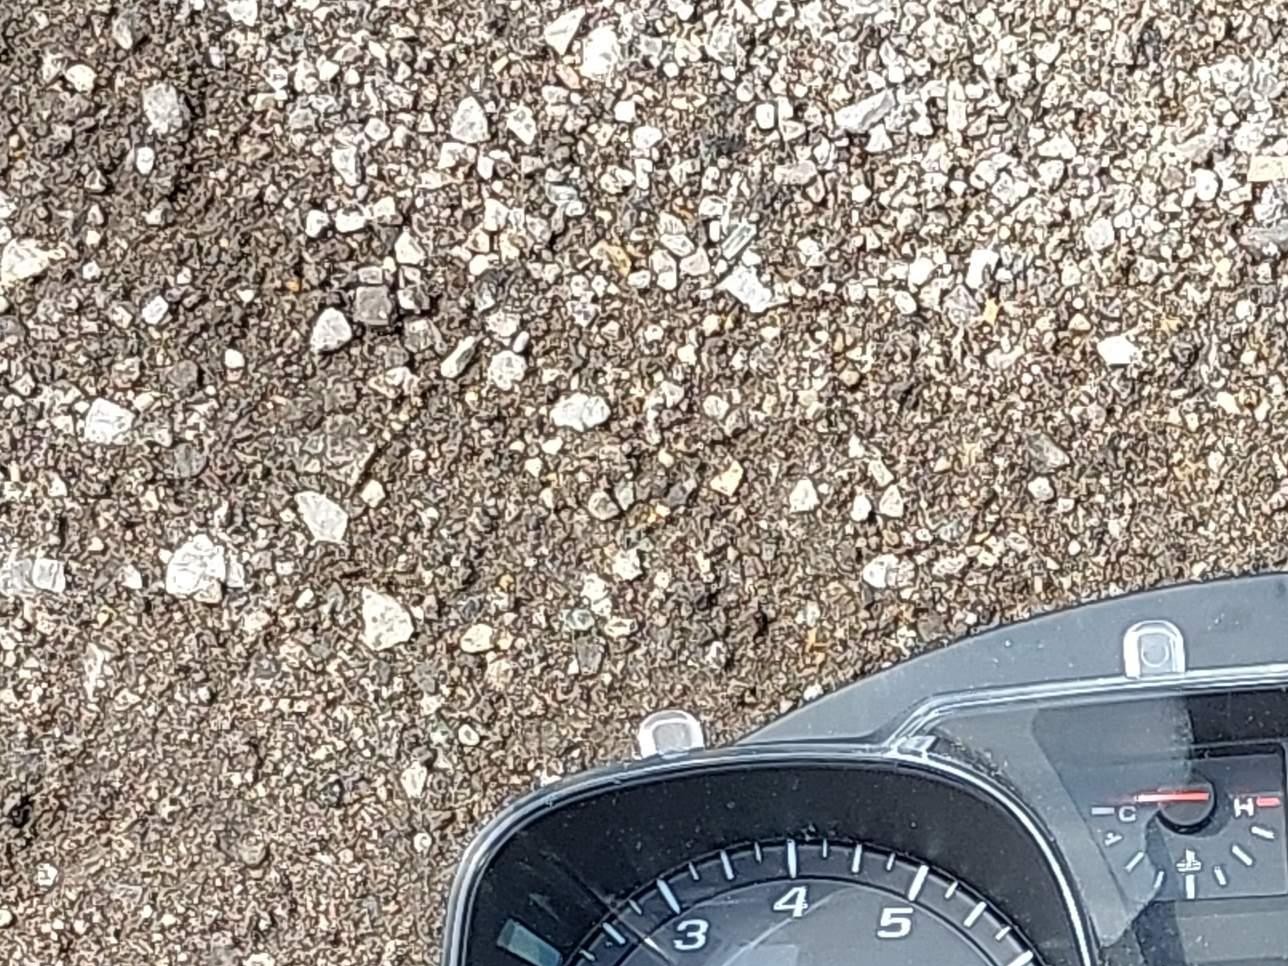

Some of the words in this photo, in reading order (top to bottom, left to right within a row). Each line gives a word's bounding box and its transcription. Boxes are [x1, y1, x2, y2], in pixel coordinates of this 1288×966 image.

[1118, 804, 1137, 821] C
[1234, 797, 1254, 816] H
[772, 886, 808, 916] 4
[674, 920, 709, 950] 3
[875, 908, 912, 938] 5
